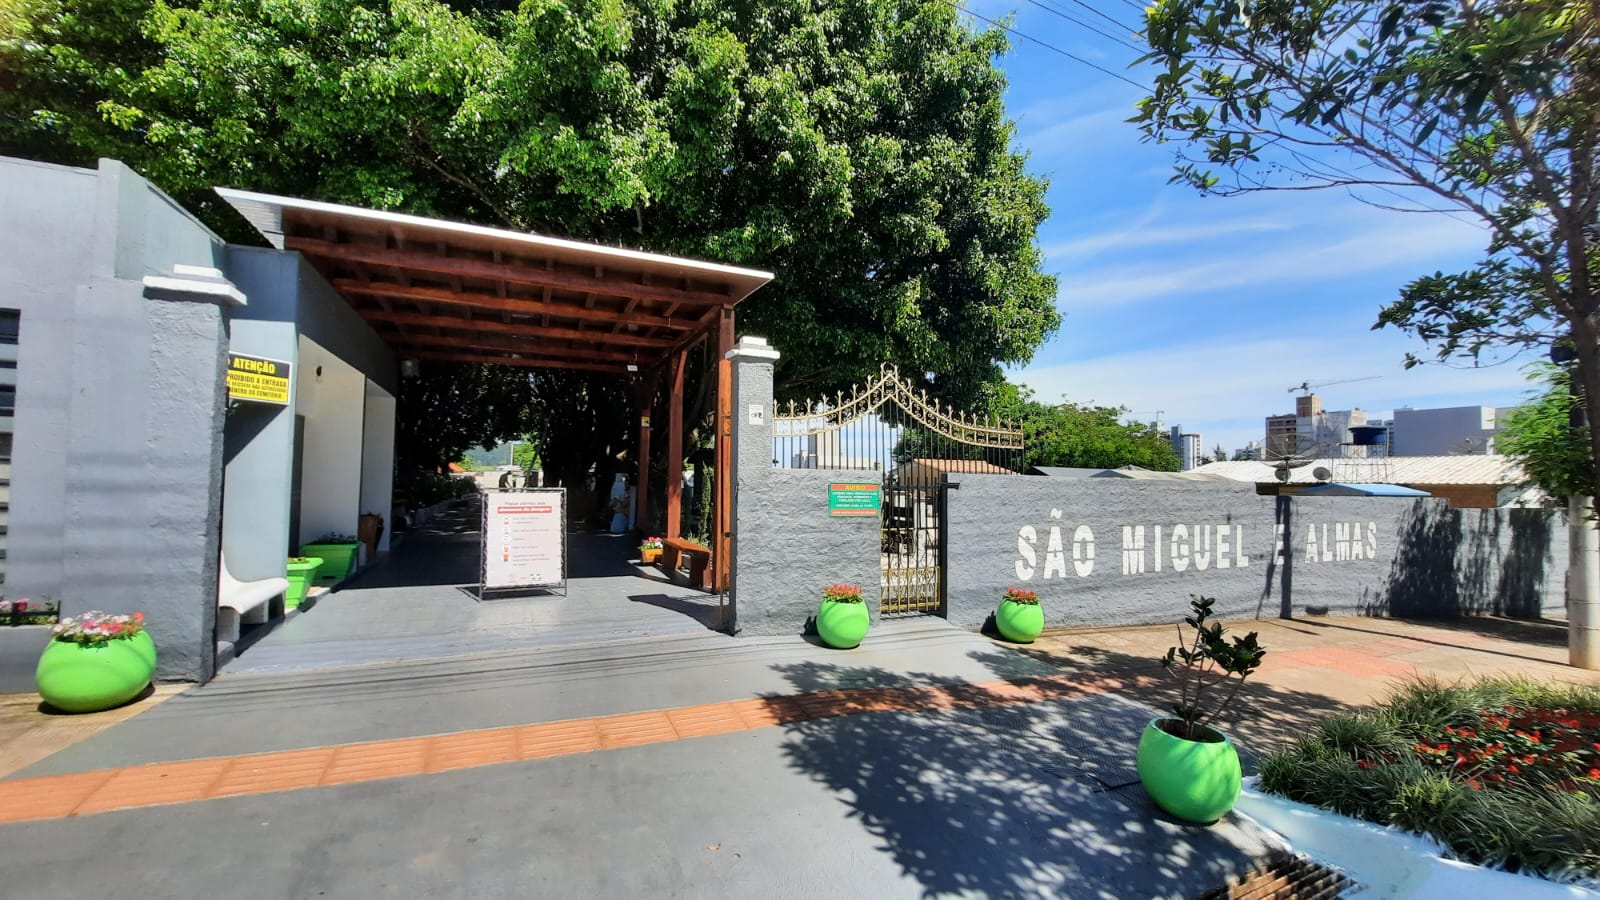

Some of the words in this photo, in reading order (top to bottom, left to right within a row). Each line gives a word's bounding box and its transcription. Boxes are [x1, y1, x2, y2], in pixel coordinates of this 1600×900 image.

[233, 357, 276, 375] ATENÇÃO
[262, 378, 287, 388] ENTRADA
[1014, 508, 1095, 581] SÃO
[1122, 523, 1249, 575] MIGUEL
[1273, 524, 1288, 565] E
[1304, 521, 1377, 564] ALMAS
